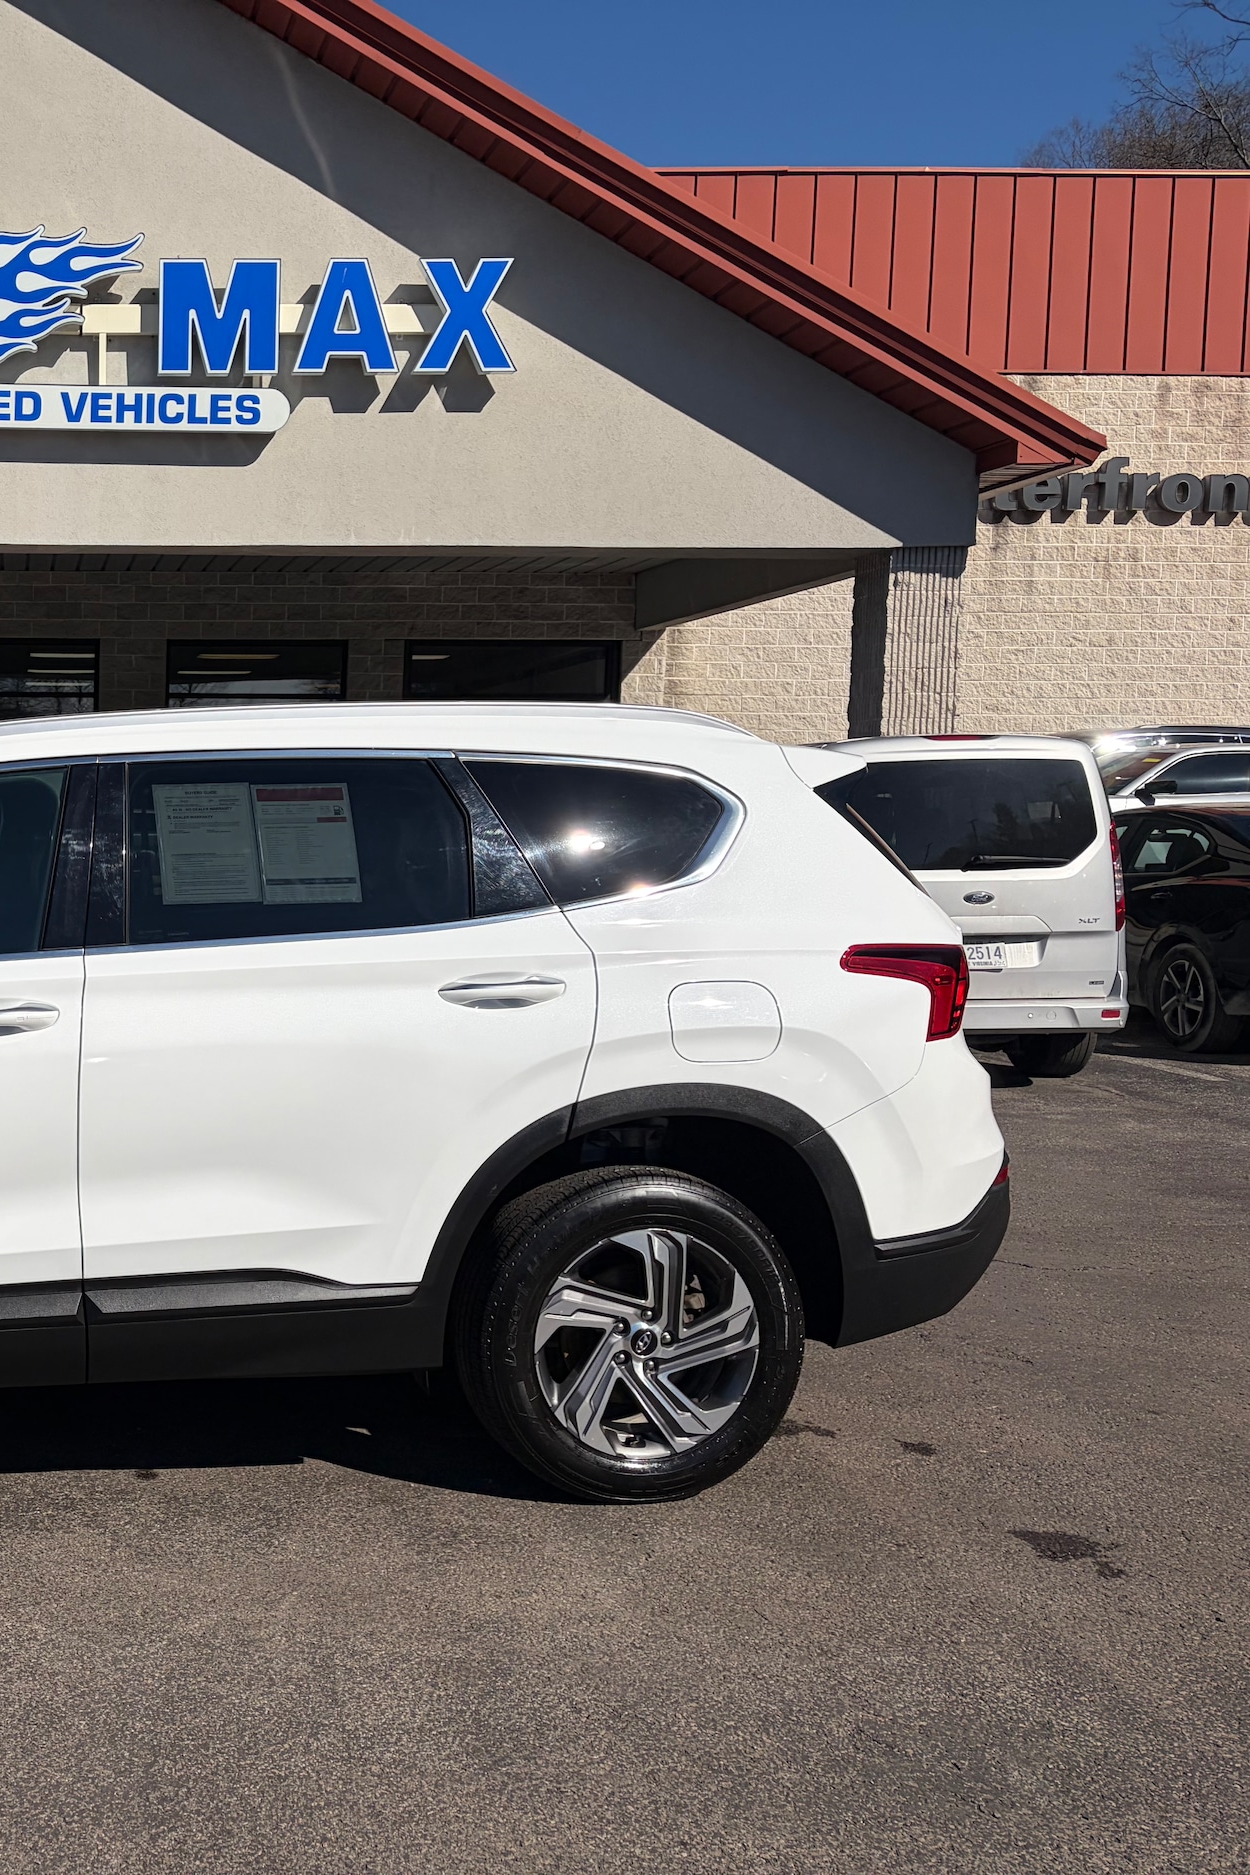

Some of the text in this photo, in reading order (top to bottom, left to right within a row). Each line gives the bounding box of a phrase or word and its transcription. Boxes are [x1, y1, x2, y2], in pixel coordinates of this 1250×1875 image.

[157, 257, 517, 376] MAX
[61, 391, 262, 425] VEHICLES
[966, 945, 1003, 960] 2514
